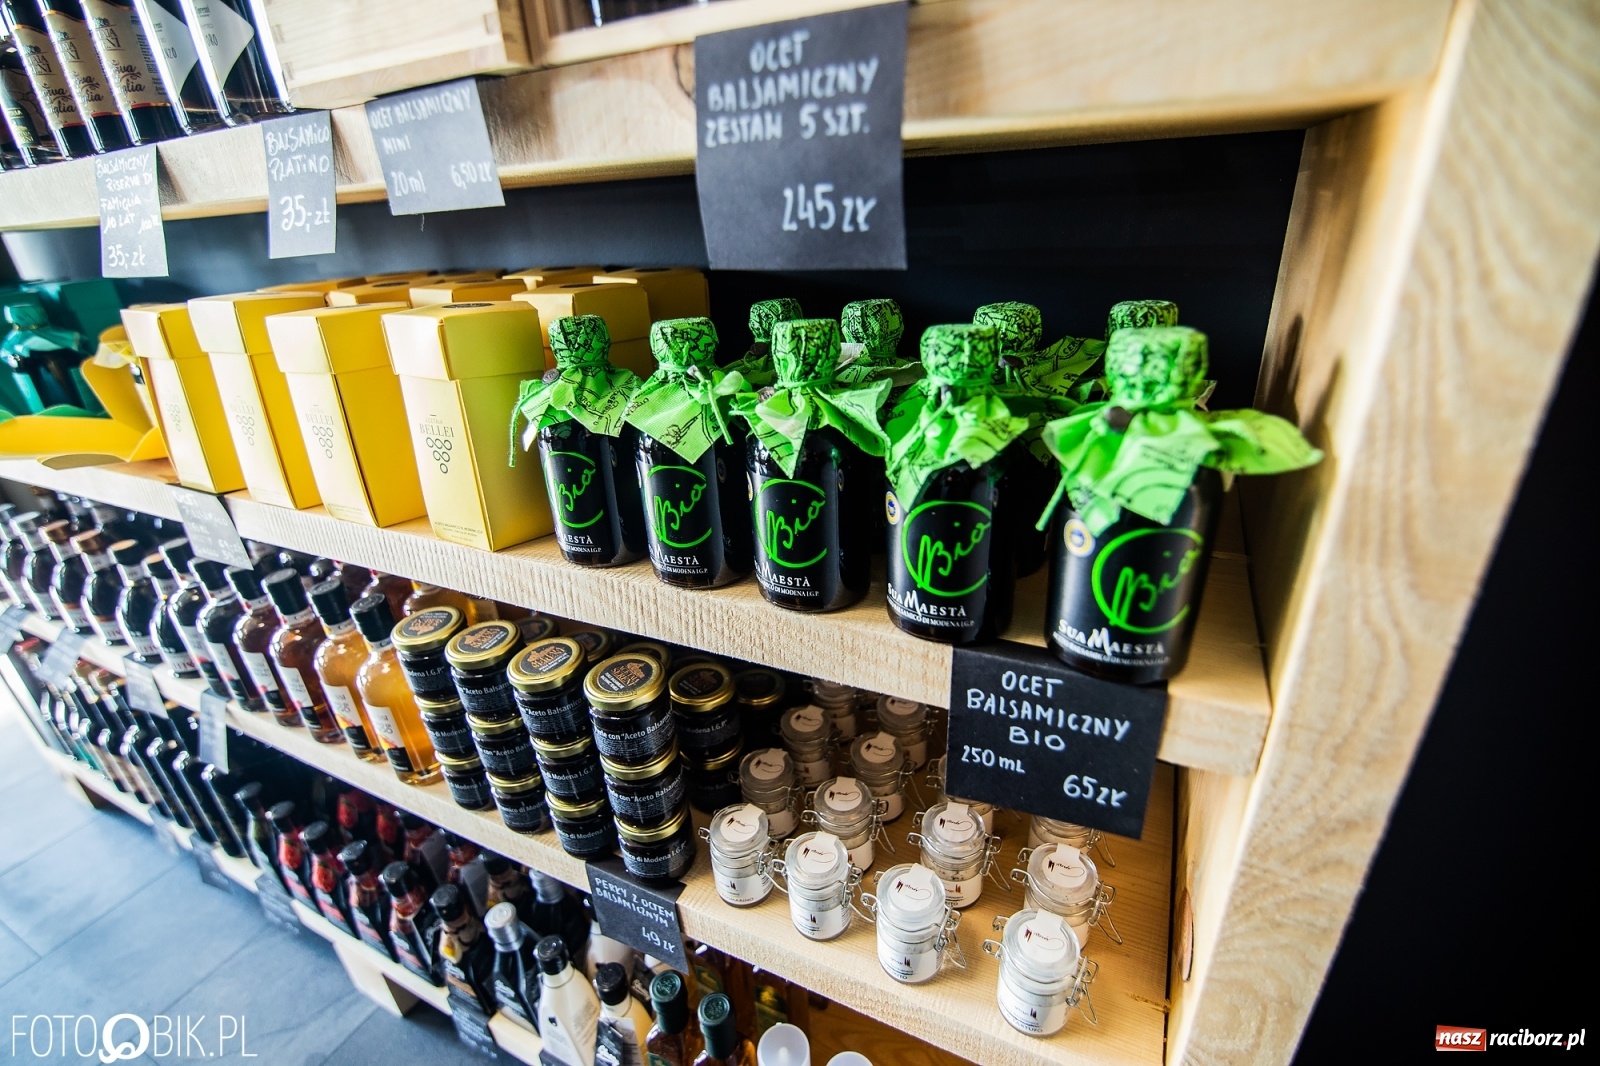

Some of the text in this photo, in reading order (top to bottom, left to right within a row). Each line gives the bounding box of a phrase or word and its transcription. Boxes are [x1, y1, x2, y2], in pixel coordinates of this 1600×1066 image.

[750, 28, 811, 73] OCET
[707, 56, 880, 112] BALSAMICZNY
[371, 106, 393, 130] OCET
[704, 102, 870, 148] ZESTAW 5 SZT.
[782, 182, 837, 232] 245
[419, 423, 455, 438] BELLEI
[561, 533, 594, 545] AESTÀ
[781, 587, 806, 597] MODENA
[904, 590, 967, 618] MAESTÀ
[930, 618, 960, 628] MODENA
[1087, 627, 1165, 656] MAESTÀ
[1001, 670, 1063, 699] OCET
[966, 688, 1131, 741] BALSAMICZNY
[608, 733, 621, 741] con
[1009, 725, 1066, 751] BIO
[961, 745, 995, 767] 250
[643, 854, 672, 863] Modena
[595, 887, 668, 928] BALSAMICZNYM
[641, 898, 675, 921] OCTEM
[642, 926, 661, 946] 49
